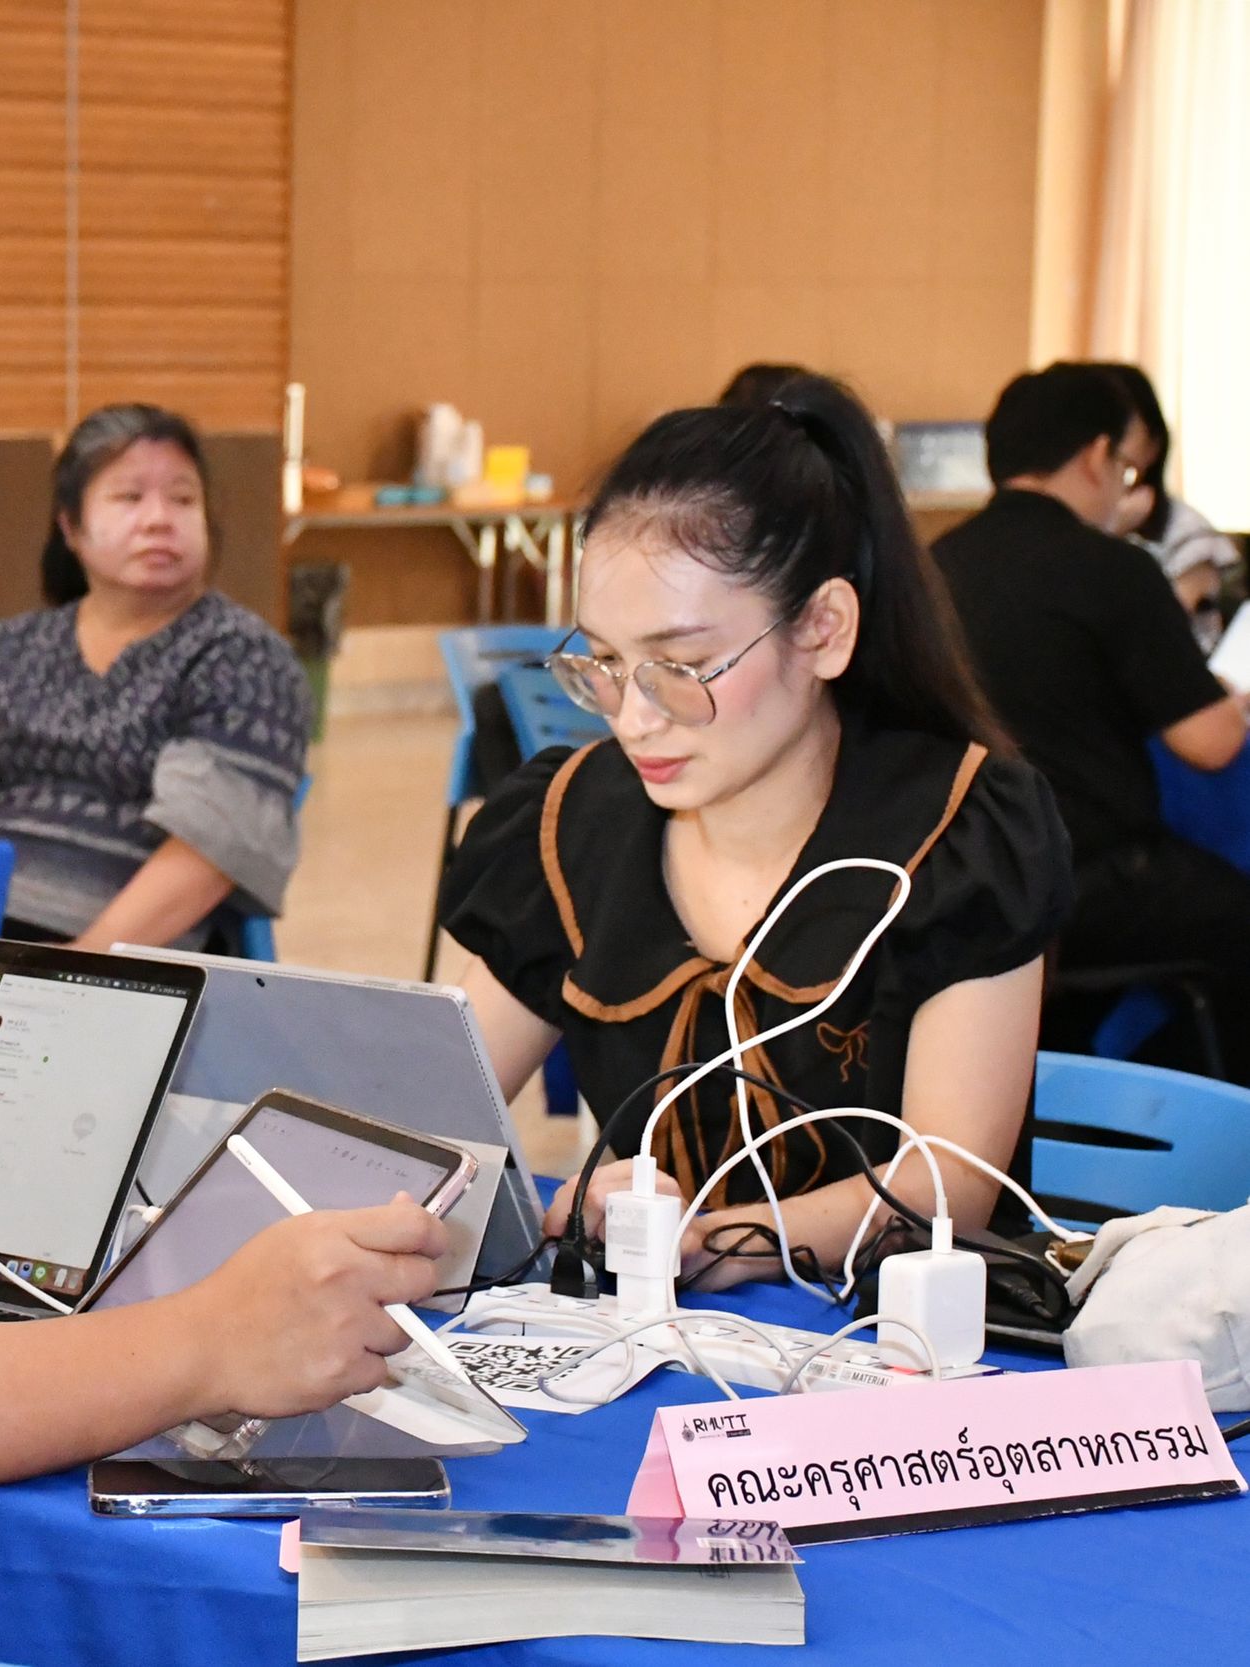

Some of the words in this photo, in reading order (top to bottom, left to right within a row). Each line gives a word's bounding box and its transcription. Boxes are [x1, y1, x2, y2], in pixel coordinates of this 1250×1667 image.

[692, 1413, 747, 1433] RMUTT
[706, 1426, 1209, 1511] คณะครุศาสตร์อุตสาหกรรม
